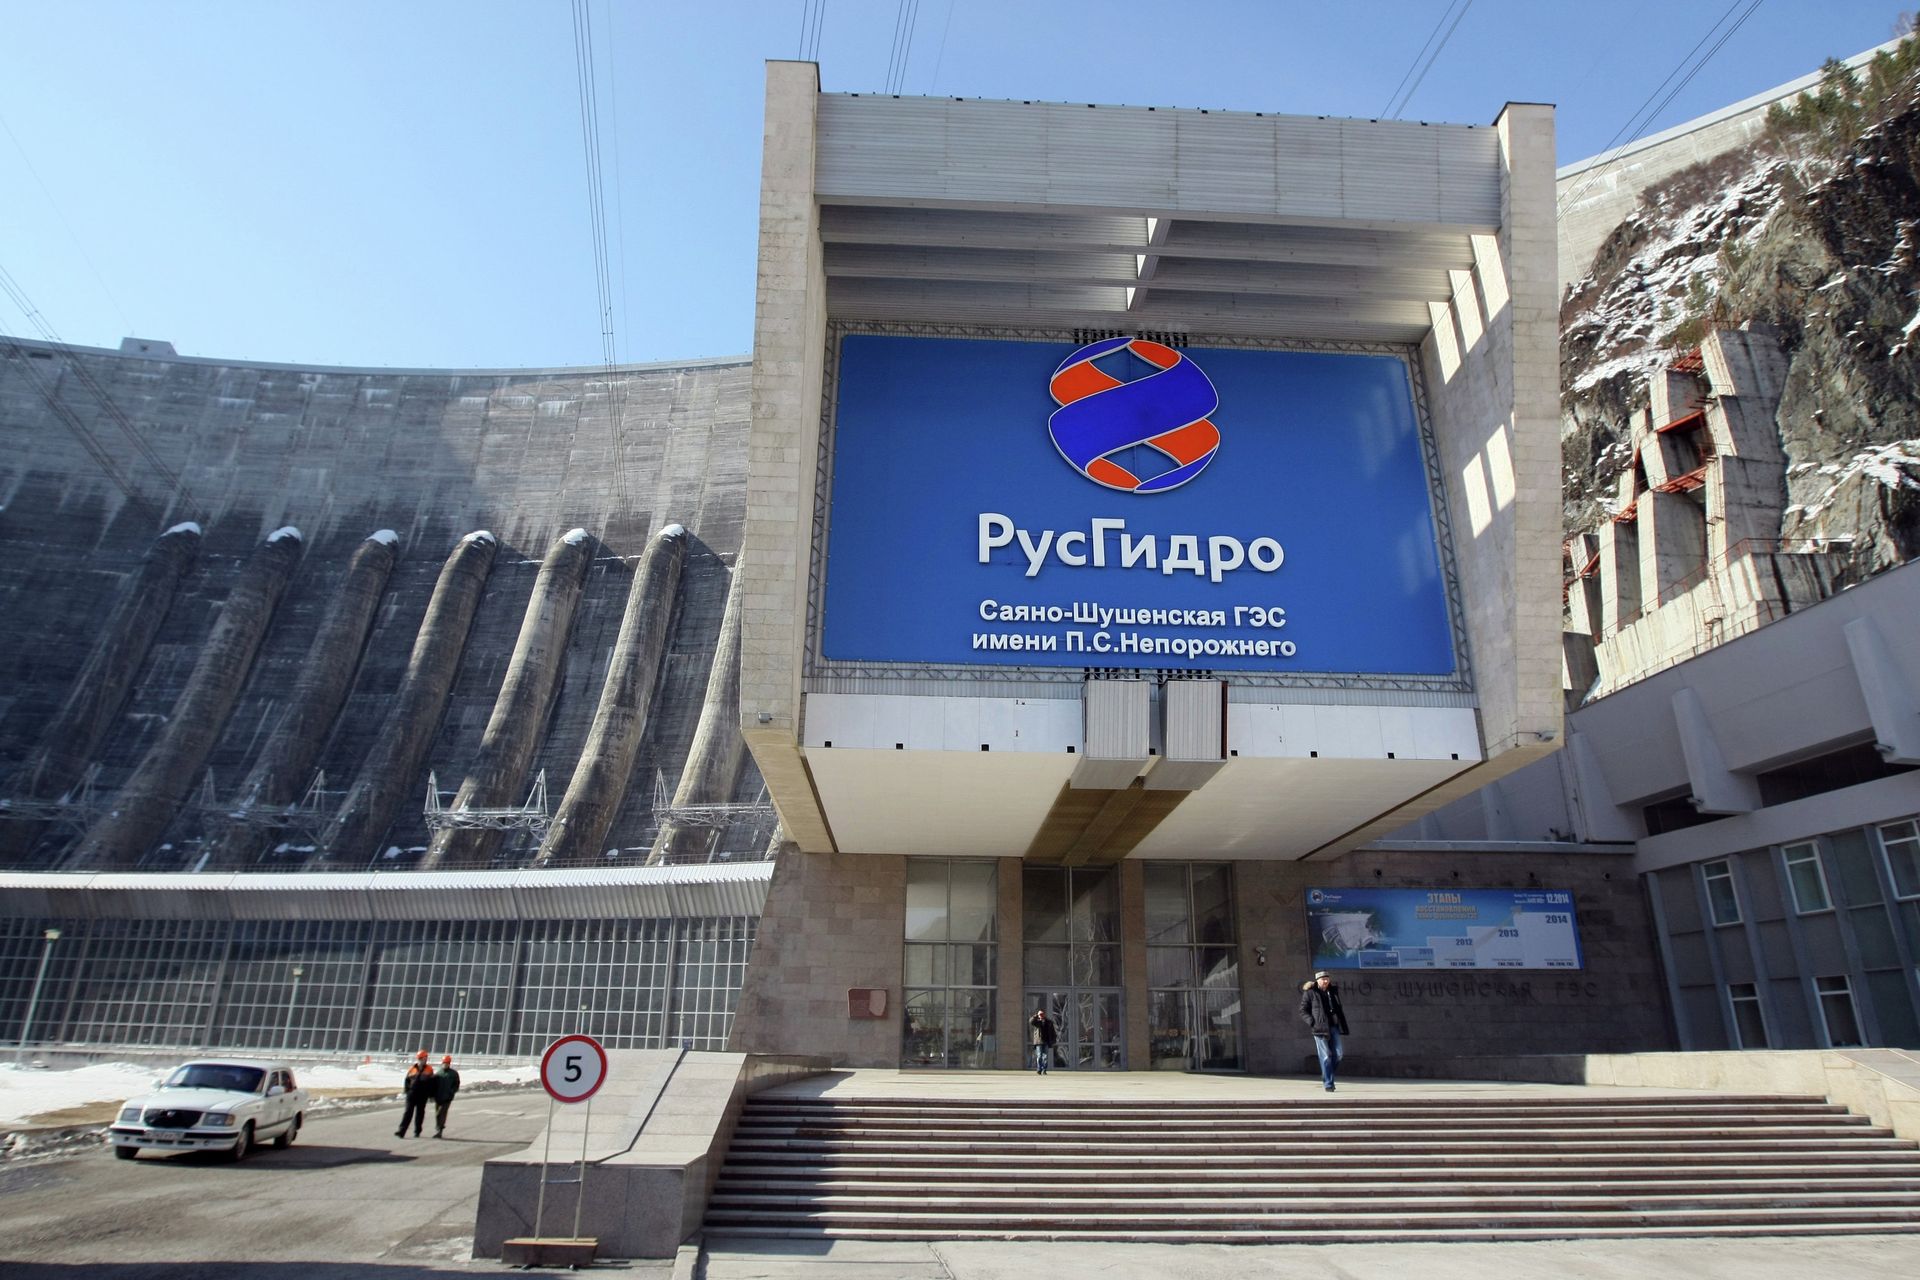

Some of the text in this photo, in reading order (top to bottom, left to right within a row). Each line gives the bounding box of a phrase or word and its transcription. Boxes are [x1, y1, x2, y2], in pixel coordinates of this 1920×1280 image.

[978, 512, 1285, 583] РусГидро
[979, 599, 1286, 628] Саяно-Шушенская ГЭС
[972, 631, 1296, 658] имени П.С.Непорожнего
[1427, 893, 1461, 903] ЭТАПЫ
[1546, 914, 1568, 924] 2014
[1456, 938, 1473, 946] 2012
[1498, 929, 1519, 938] 2013
[564, 1056, 582, 1083] 5
